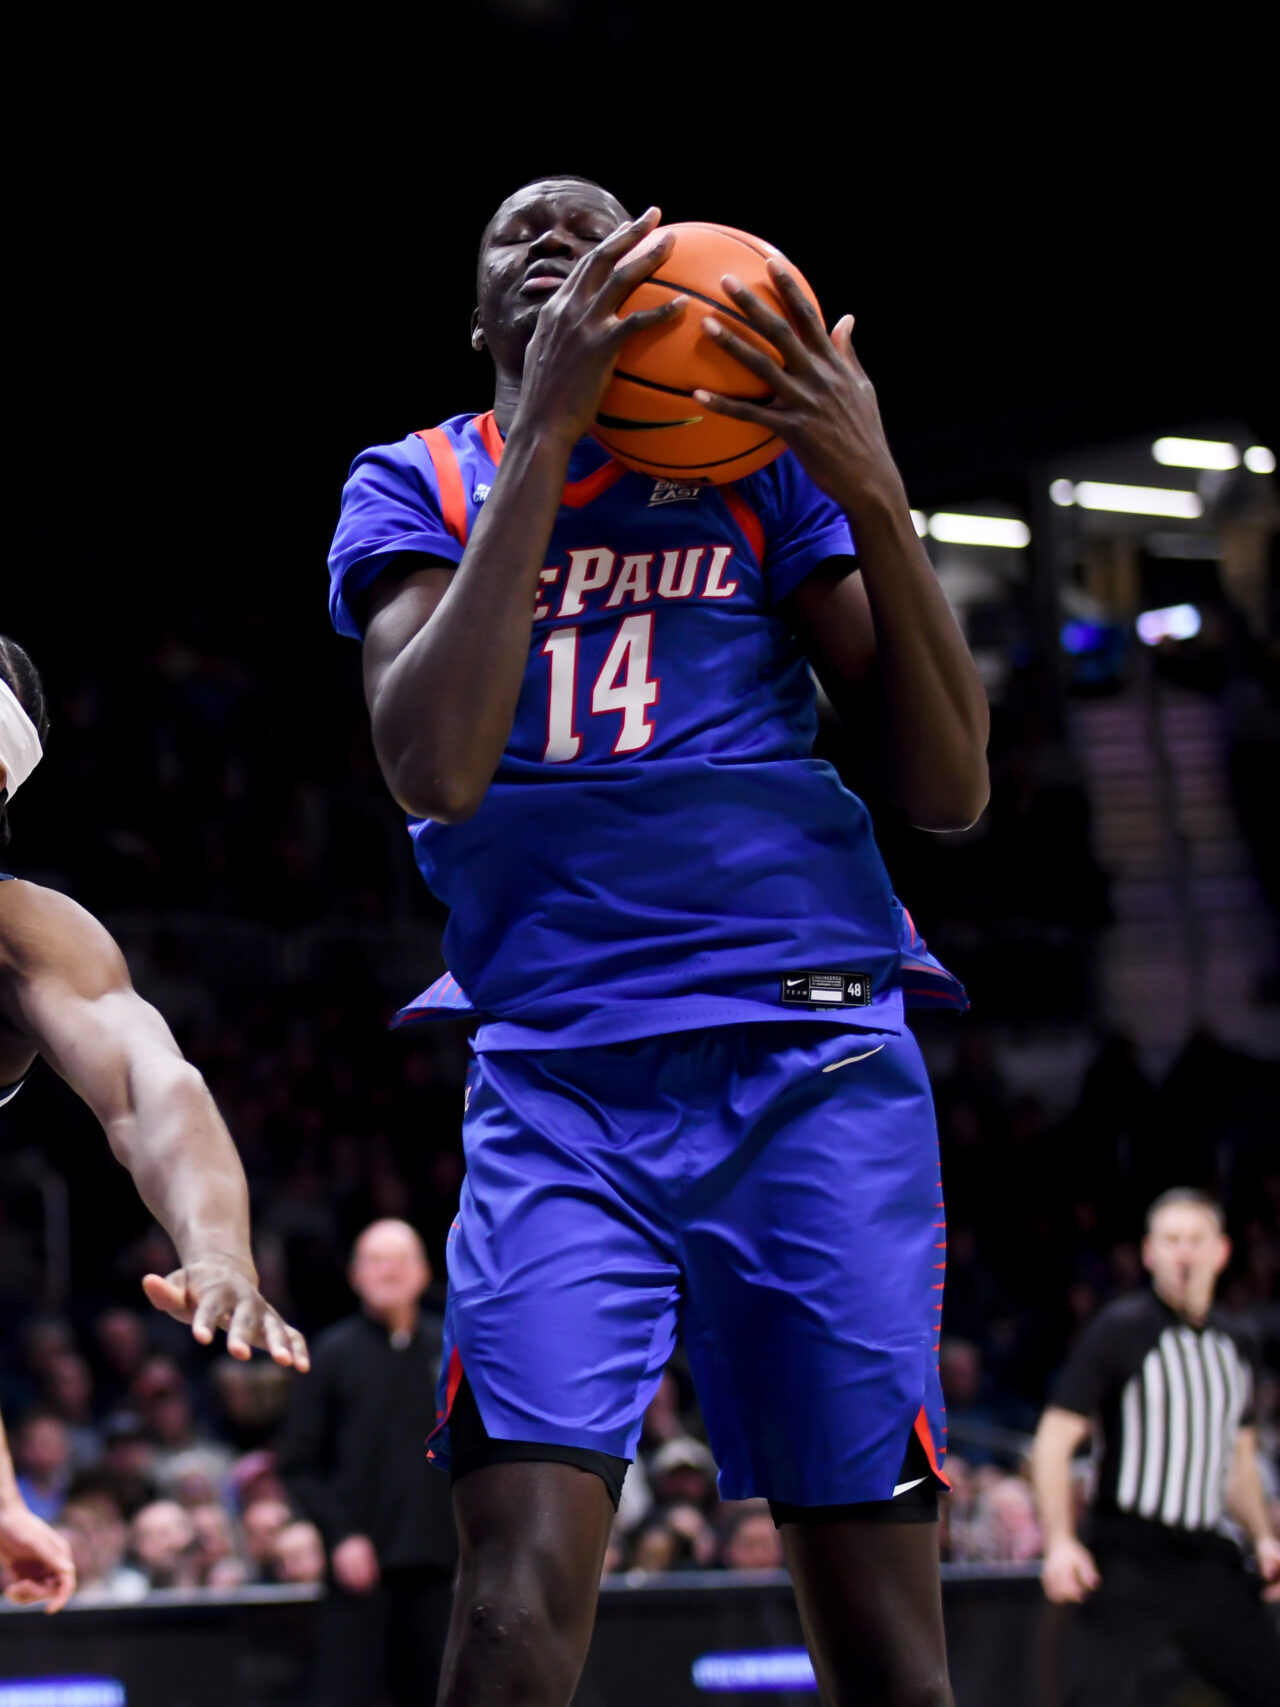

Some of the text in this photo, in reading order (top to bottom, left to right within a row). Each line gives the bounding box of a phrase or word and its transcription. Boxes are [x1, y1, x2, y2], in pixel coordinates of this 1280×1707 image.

[650, 488, 700, 501] EAST
[532, 546, 738, 621] EPAUL
[541, 611, 660, 764] 14
[847, 982, 862, 997] 48
